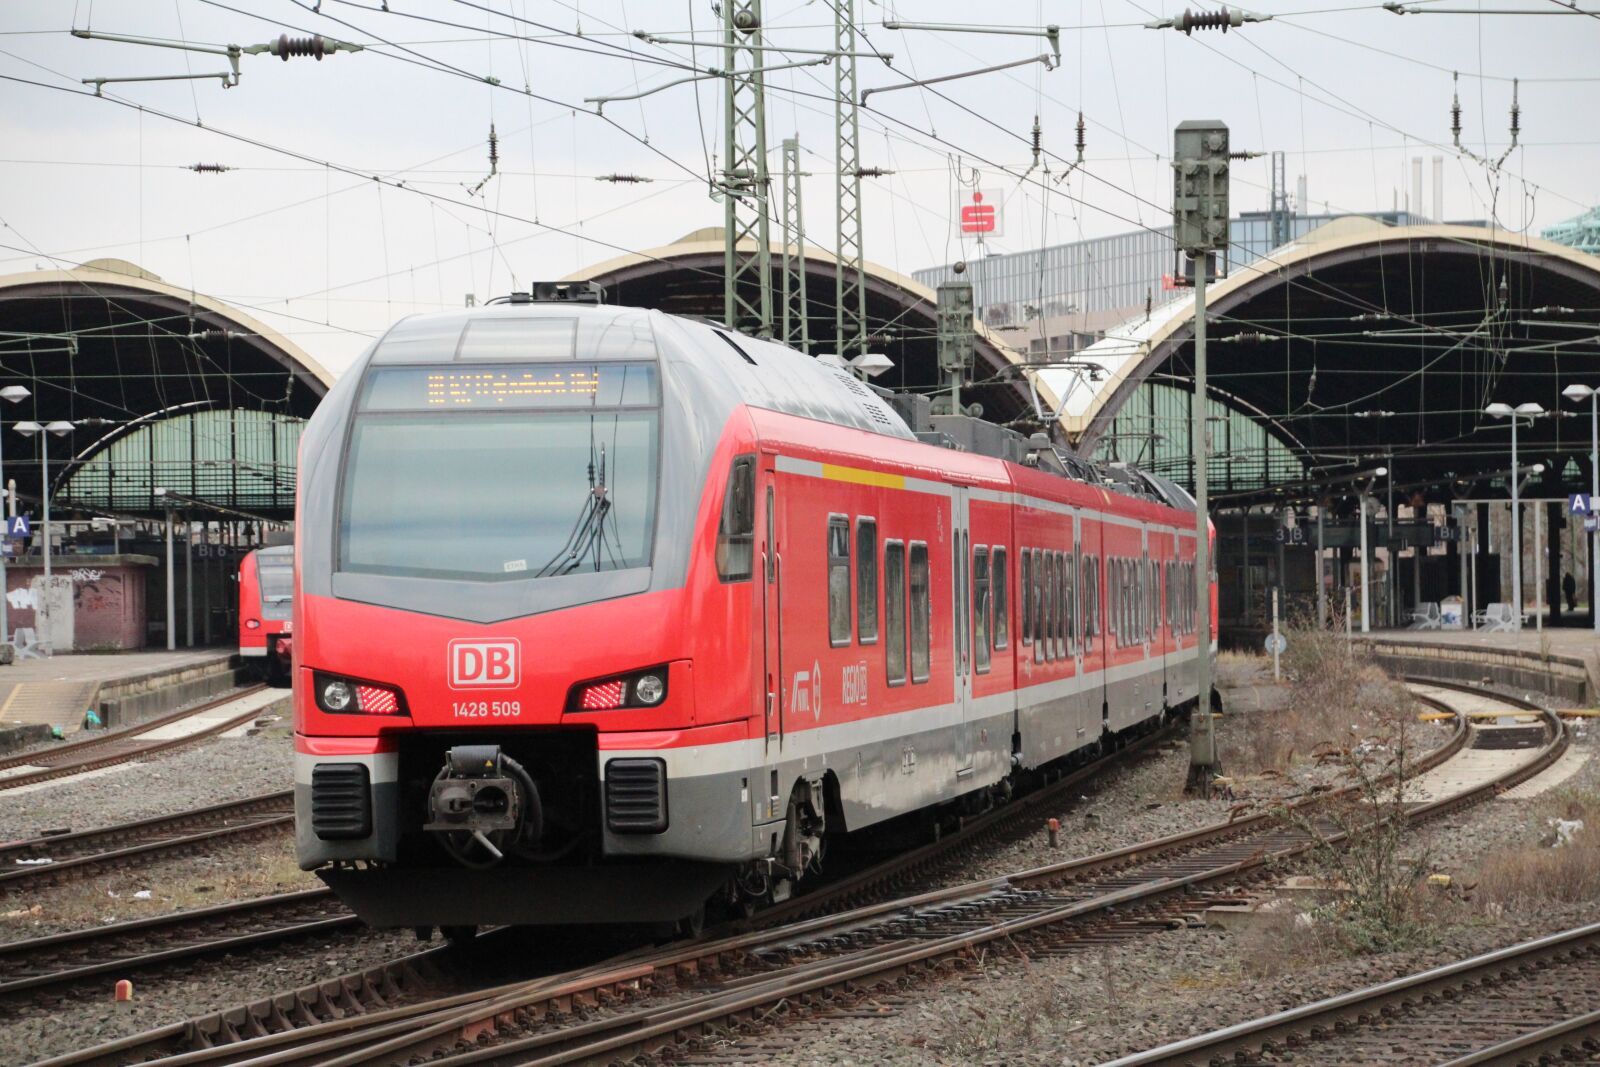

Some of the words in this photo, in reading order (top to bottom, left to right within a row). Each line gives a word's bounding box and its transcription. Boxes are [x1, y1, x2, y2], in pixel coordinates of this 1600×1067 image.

[1572, 494, 1586, 511] A
[13, 516, 28, 533] A
[217, 544, 227, 557] 6
[456, 645, 513, 682] DB
[452, 701, 488, 718] 1428
[491, 700, 521, 717] 509
